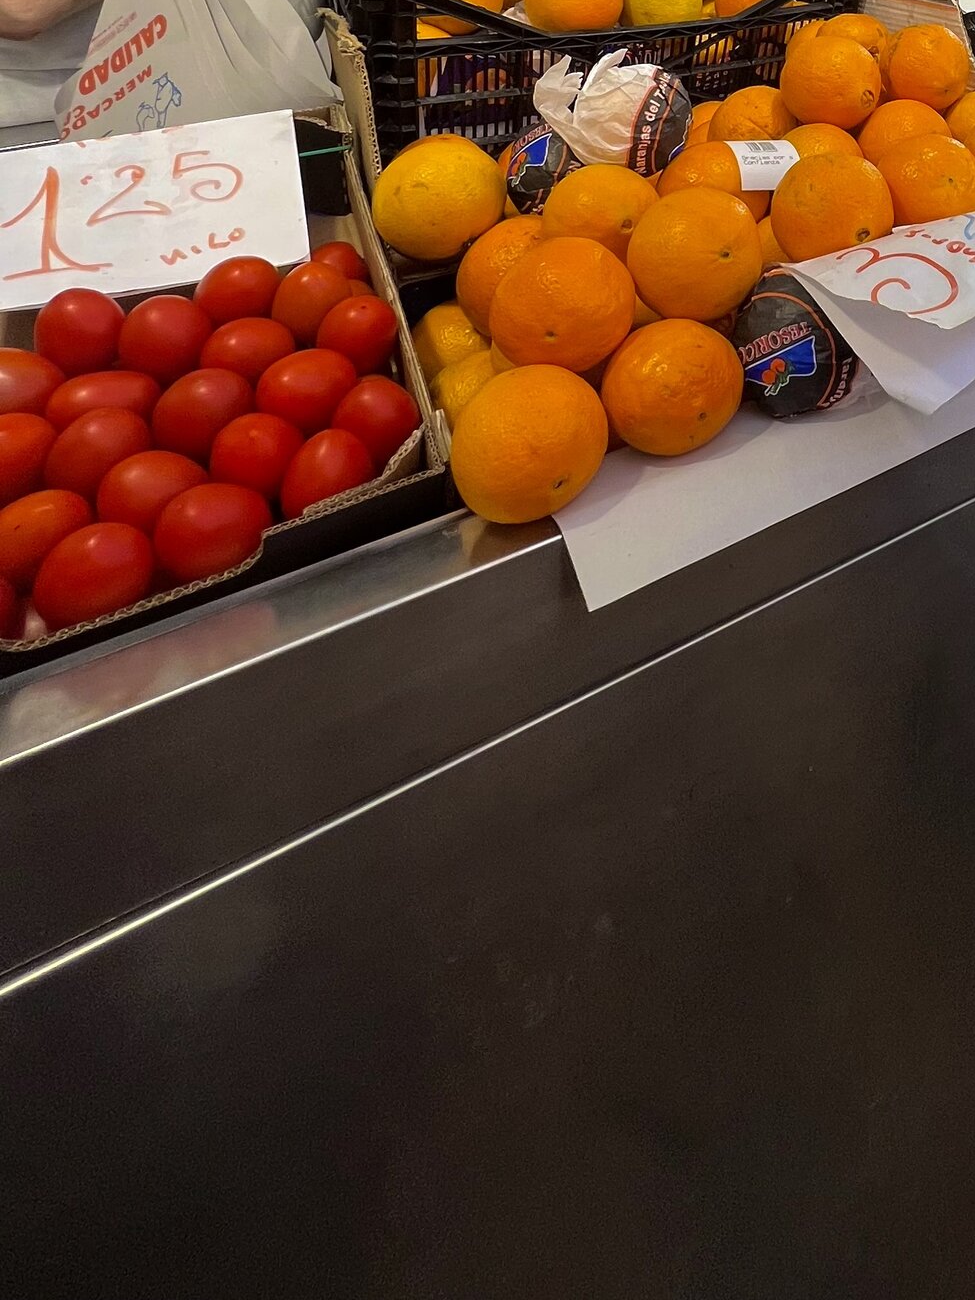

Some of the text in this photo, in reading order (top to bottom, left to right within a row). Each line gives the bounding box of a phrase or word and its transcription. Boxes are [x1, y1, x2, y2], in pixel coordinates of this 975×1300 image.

[79, 14, 168, 96] CALIDAD
[633, 126, 652, 174] Naranjas
[647, 99, 661, 121] del
